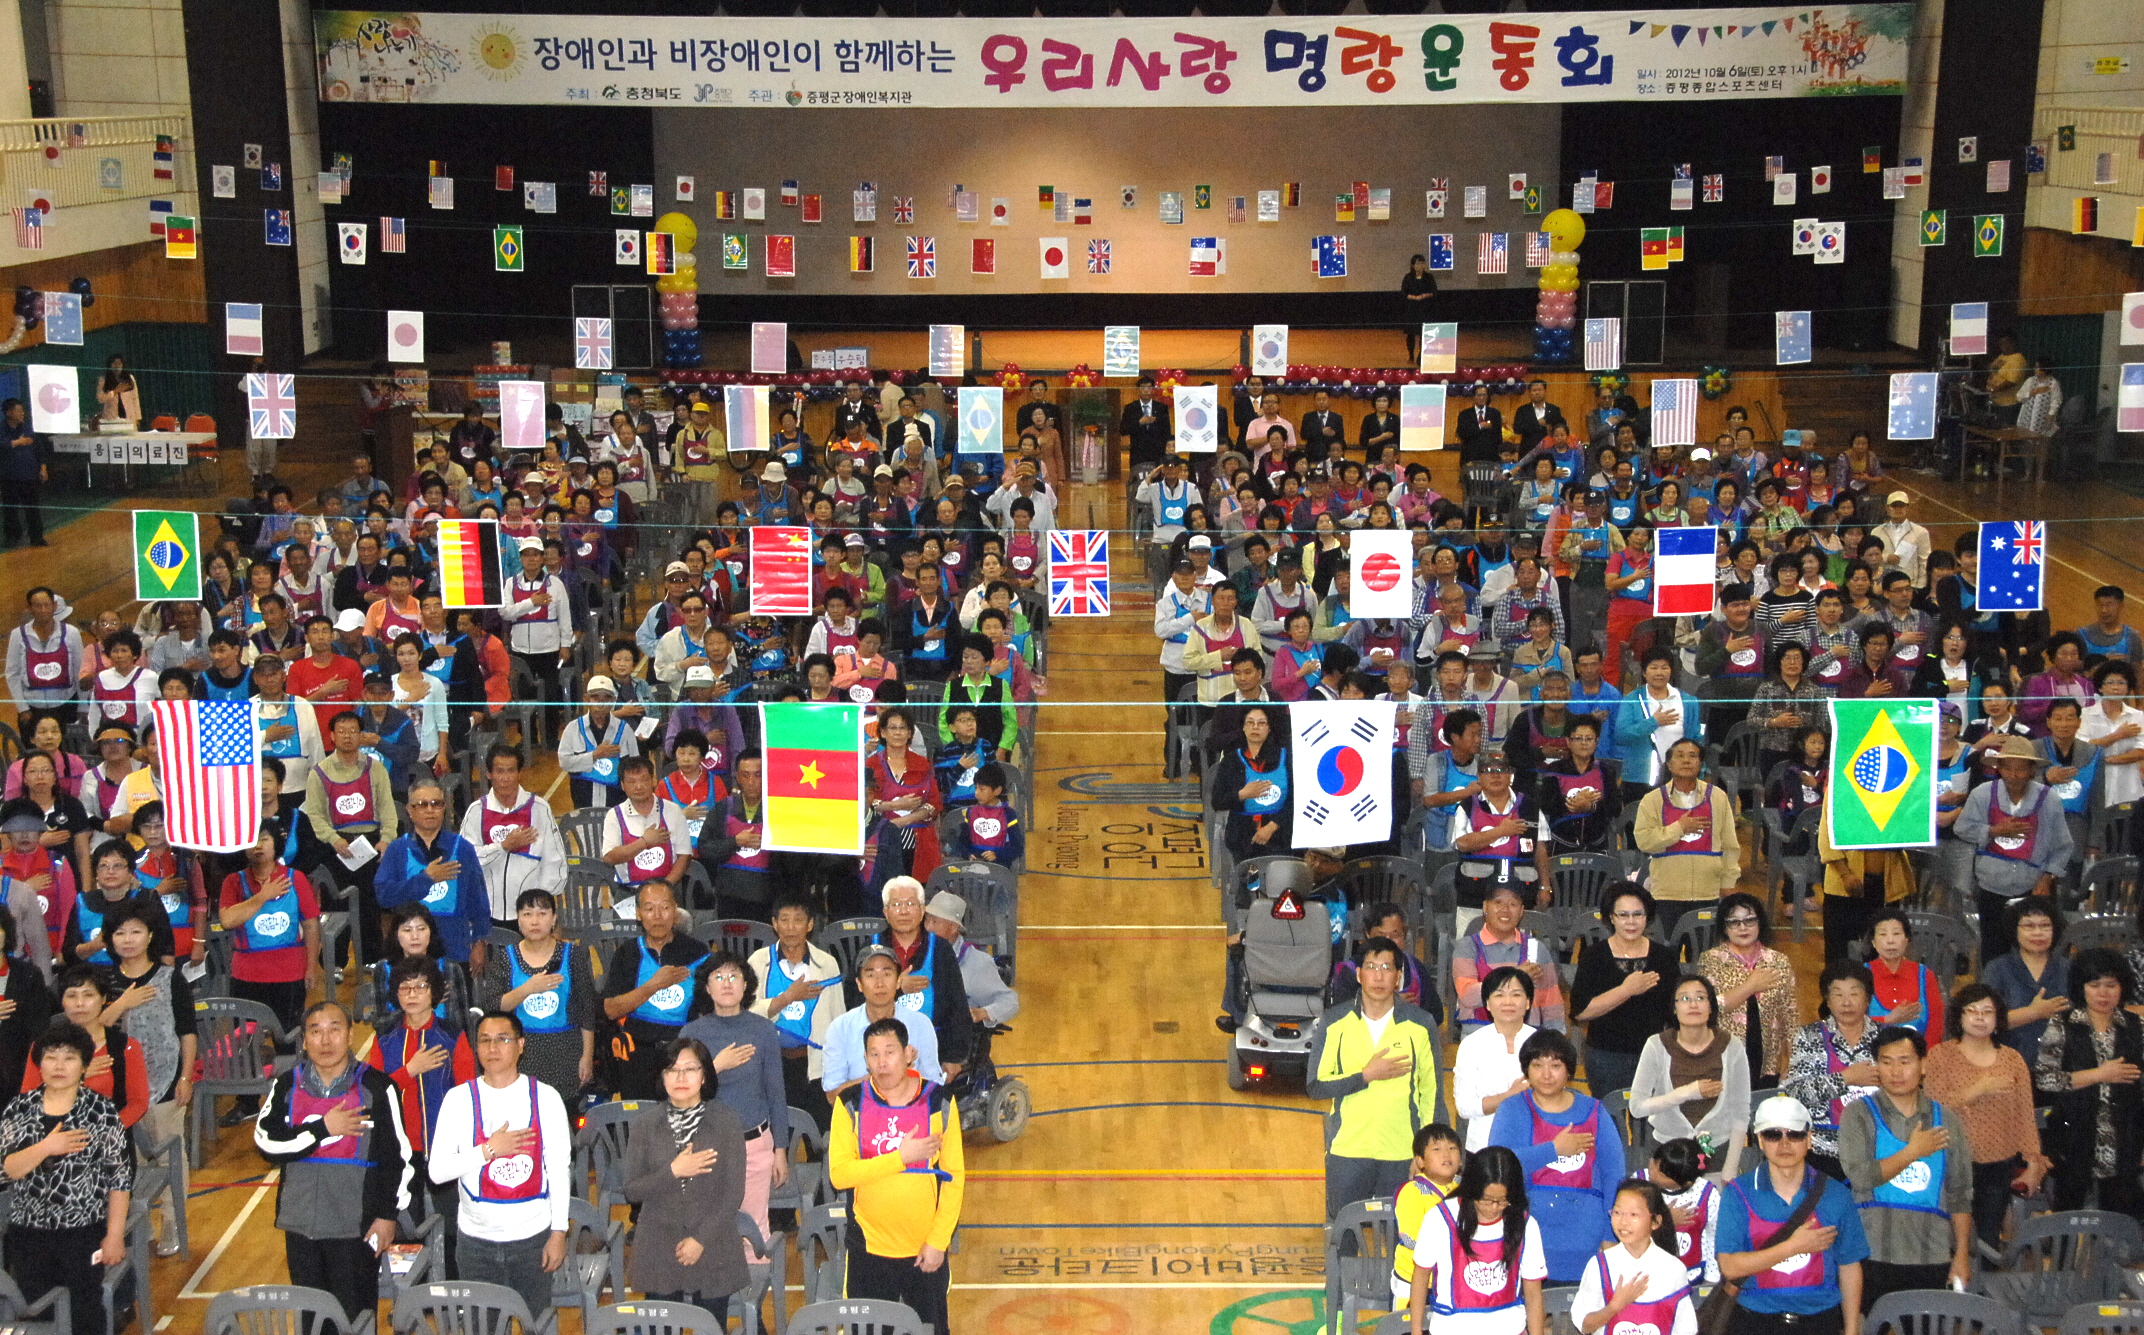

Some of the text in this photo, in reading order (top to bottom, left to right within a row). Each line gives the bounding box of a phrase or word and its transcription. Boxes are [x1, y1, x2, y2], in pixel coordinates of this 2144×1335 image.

[533, 36, 658, 72] 장애인과
[669, 38, 821, 73] 비장애인이
[833, 39, 956, 73] 함께하는
[981, 32, 1238, 95] 우리사랑
[1665, 68, 1701, 79] 2012년
[1704, 67, 1726, 78] 10월
[1728, 65, 1764, 78] 6일(토)
[1767, 65, 1786, 77] 오후
[1790, 64, 1807, 76] 1시
[626, 87, 682, 100] 충청북도
[1665, 79, 1783, 95] 증평종합스포츠센터
[94, 443, 184, 460] 응급의료진
[1046, 807, 1089, 869] Jeung Pyeong
